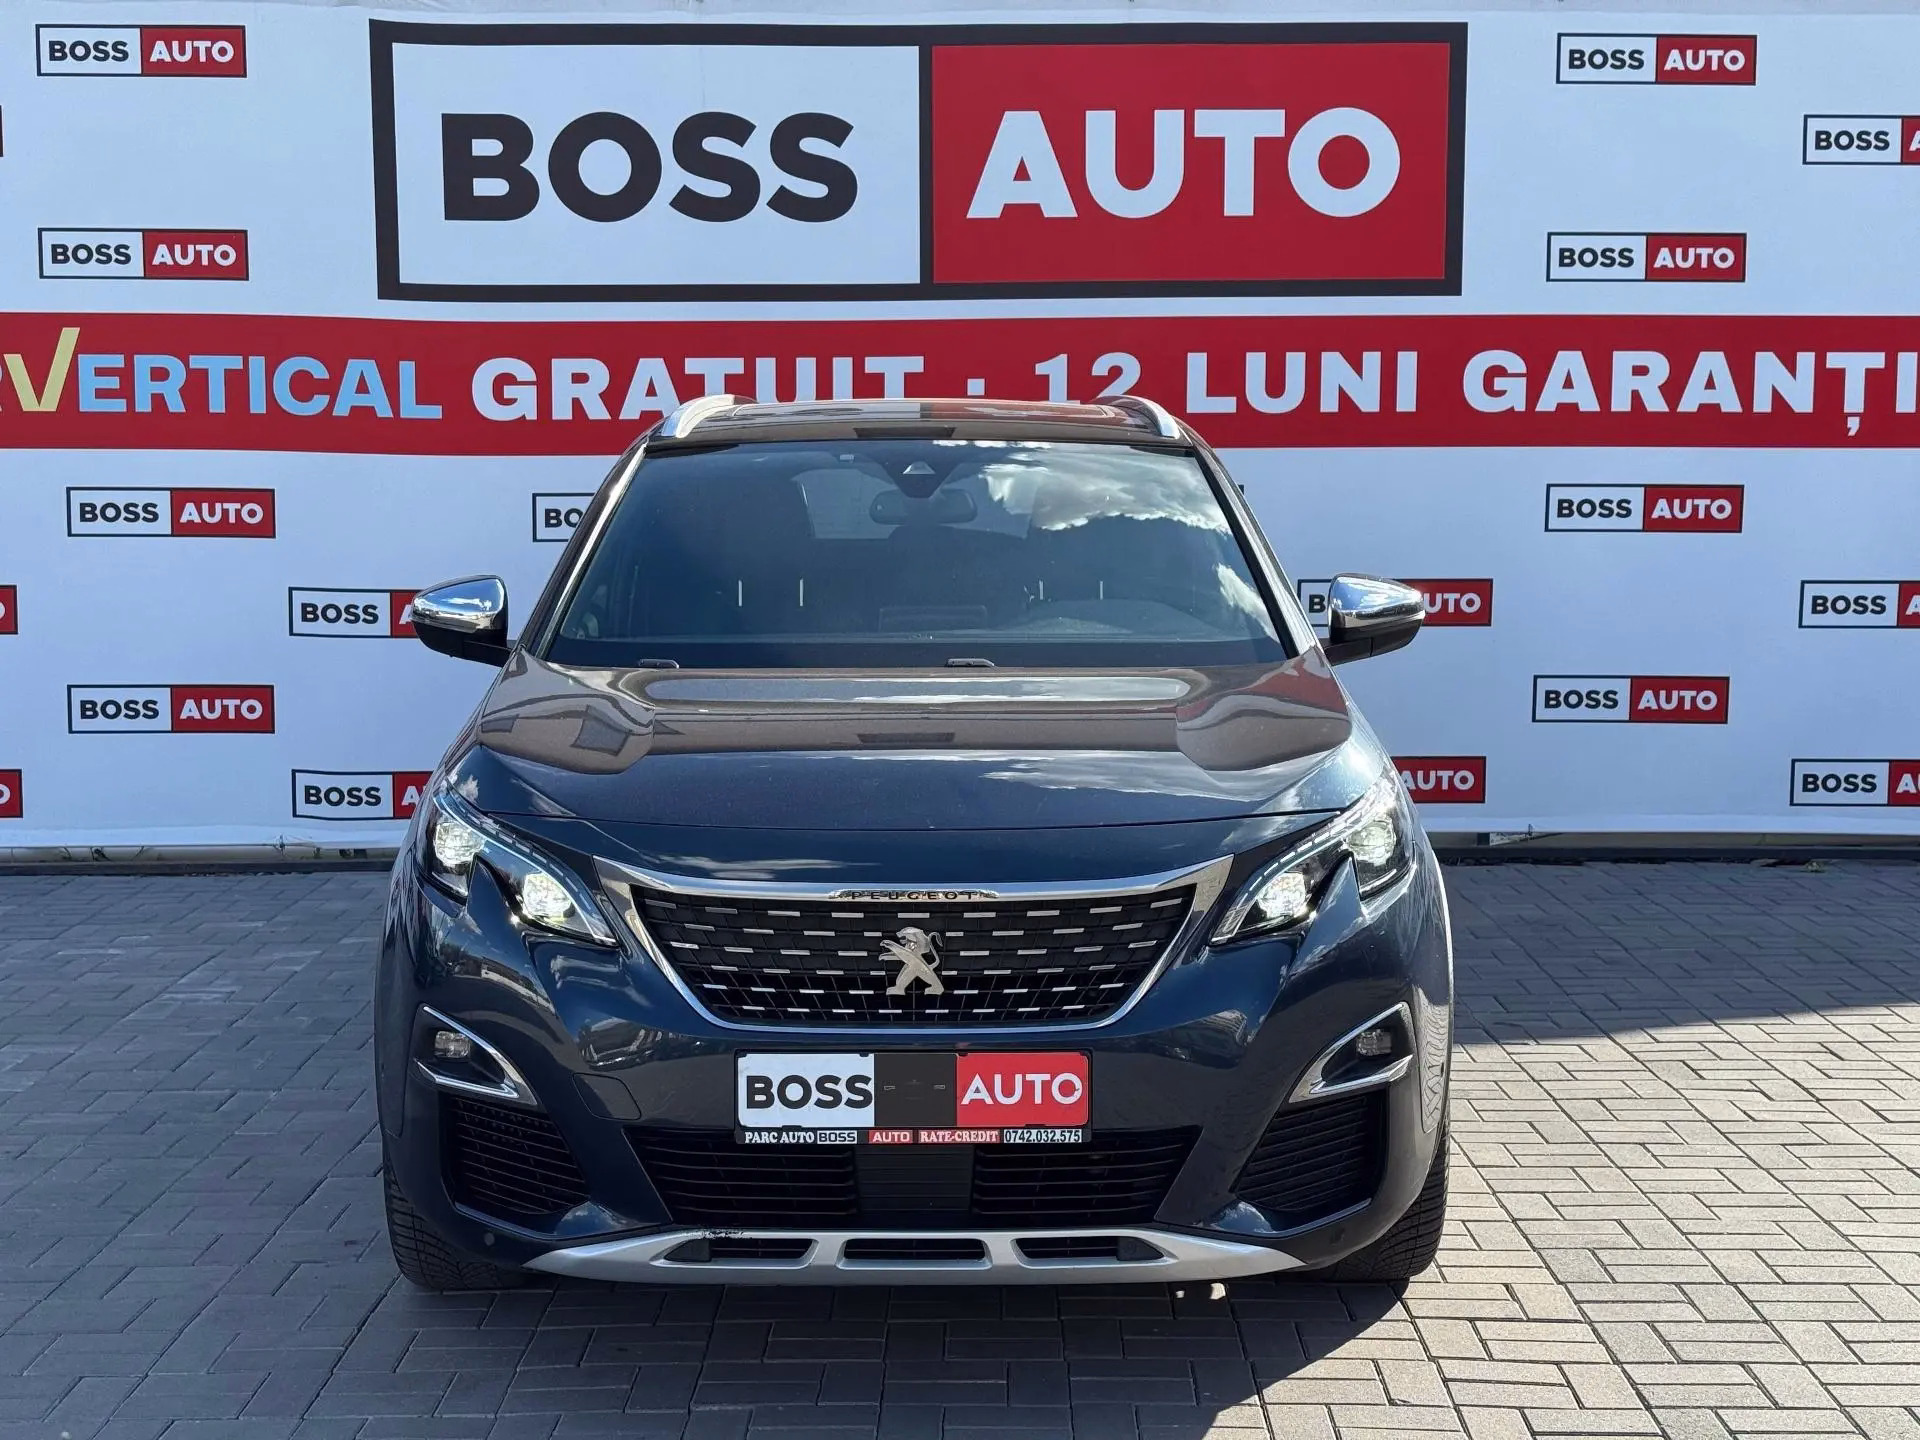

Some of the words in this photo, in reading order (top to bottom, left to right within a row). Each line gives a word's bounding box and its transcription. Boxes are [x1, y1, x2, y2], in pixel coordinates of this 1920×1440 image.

[48, 40, 129, 62] BOSS
[150, 41, 234, 63] AUTO
[1568, 49, 1645, 70] BOSS
[1664, 49, 1745, 71] AUTO
[1814, 130, 1890, 151] BOSS
[441, 111, 858, 222] BOSS
[966, 107, 1400, 218] AUTO
[51, 244, 132, 265] BOSS
[152, 244, 236, 266] AUTO
[1558, 247, 1634, 268] BOSS
[1654, 247, 1735, 269] AUTO
[0, 327, 442, 418] VERTICAL
[471, 356, 924, 421] GRATUIT
[1035, 351, 1141, 404] 12
[1186, 350, 1418, 413] LUNI
[79, 502, 160, 523] BOSS
[179, 503, 264, 524] AUTO
[544, 508, 584, 528] BO
[1556, 498, 1632, 519] BOSS
[1651, 498, 1733, 520] AUTO
[301, 602, 379, 624] BOSS
[1423, 593, 1481, 614] UTO
[1810, 595, 1886, 615] BOSS
[80, 699, 160, 720] BOSS
[179, 699, 263, 720] AUTO
[1544, 690, 1619, 710] BOSS
[1638, 690, 1718, 711] AUTO
[1802, 774, 1877, 794] BOSS
[304, 785, 382, 807] BOSS
[851, 891, 978, 900] PEUGEOT
[745, 1074, 873, 1110] BOSS
[961, 1072, 1082, 1106] AUTO
[744, 1131, 779, 1144] PARC
[780, 1131, 815, 1144] AUTO
[818, 1131, 856, 1143] BOSS
[872, 1131, 910, 1143] AUTO
[920, 1130, 999, 1143] RATE-CREDIT
[1004, 1130, 1081, 1143] 0742.032.575
